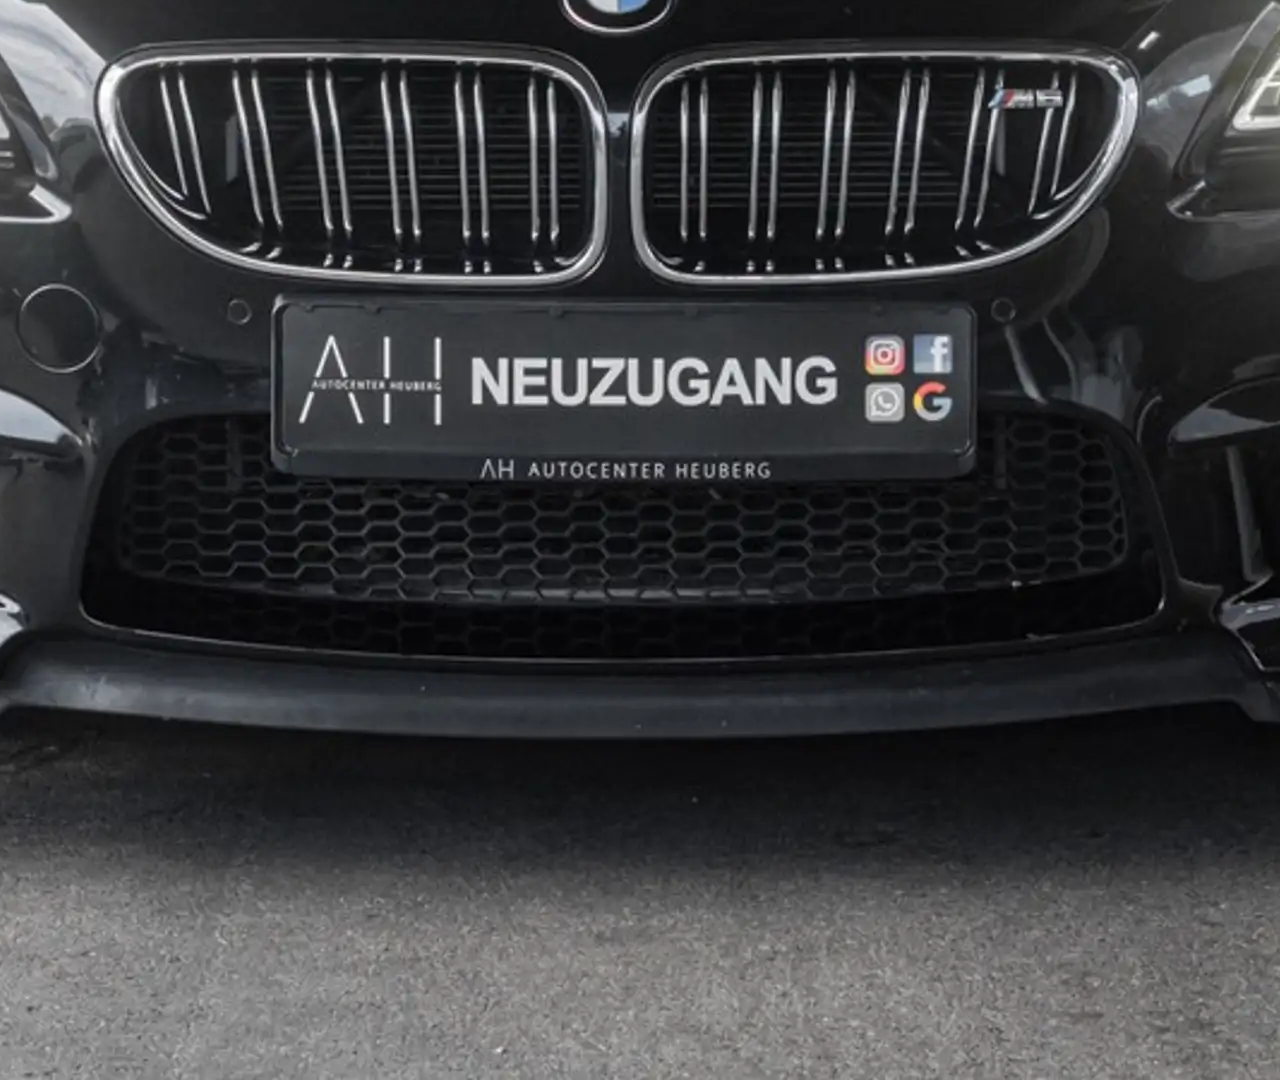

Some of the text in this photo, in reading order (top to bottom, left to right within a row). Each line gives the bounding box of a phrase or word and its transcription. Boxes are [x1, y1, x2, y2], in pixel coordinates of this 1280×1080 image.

[298, 334, 442, 426] AH
[311, 379, 442, 392] AUTOCENTER HEUBERG
[471, 356, 838, 407] NEUZUGANG
[527, 461, 666, 480] AUTOCENTER
[675, 461, 772, 480] HEUBERG
